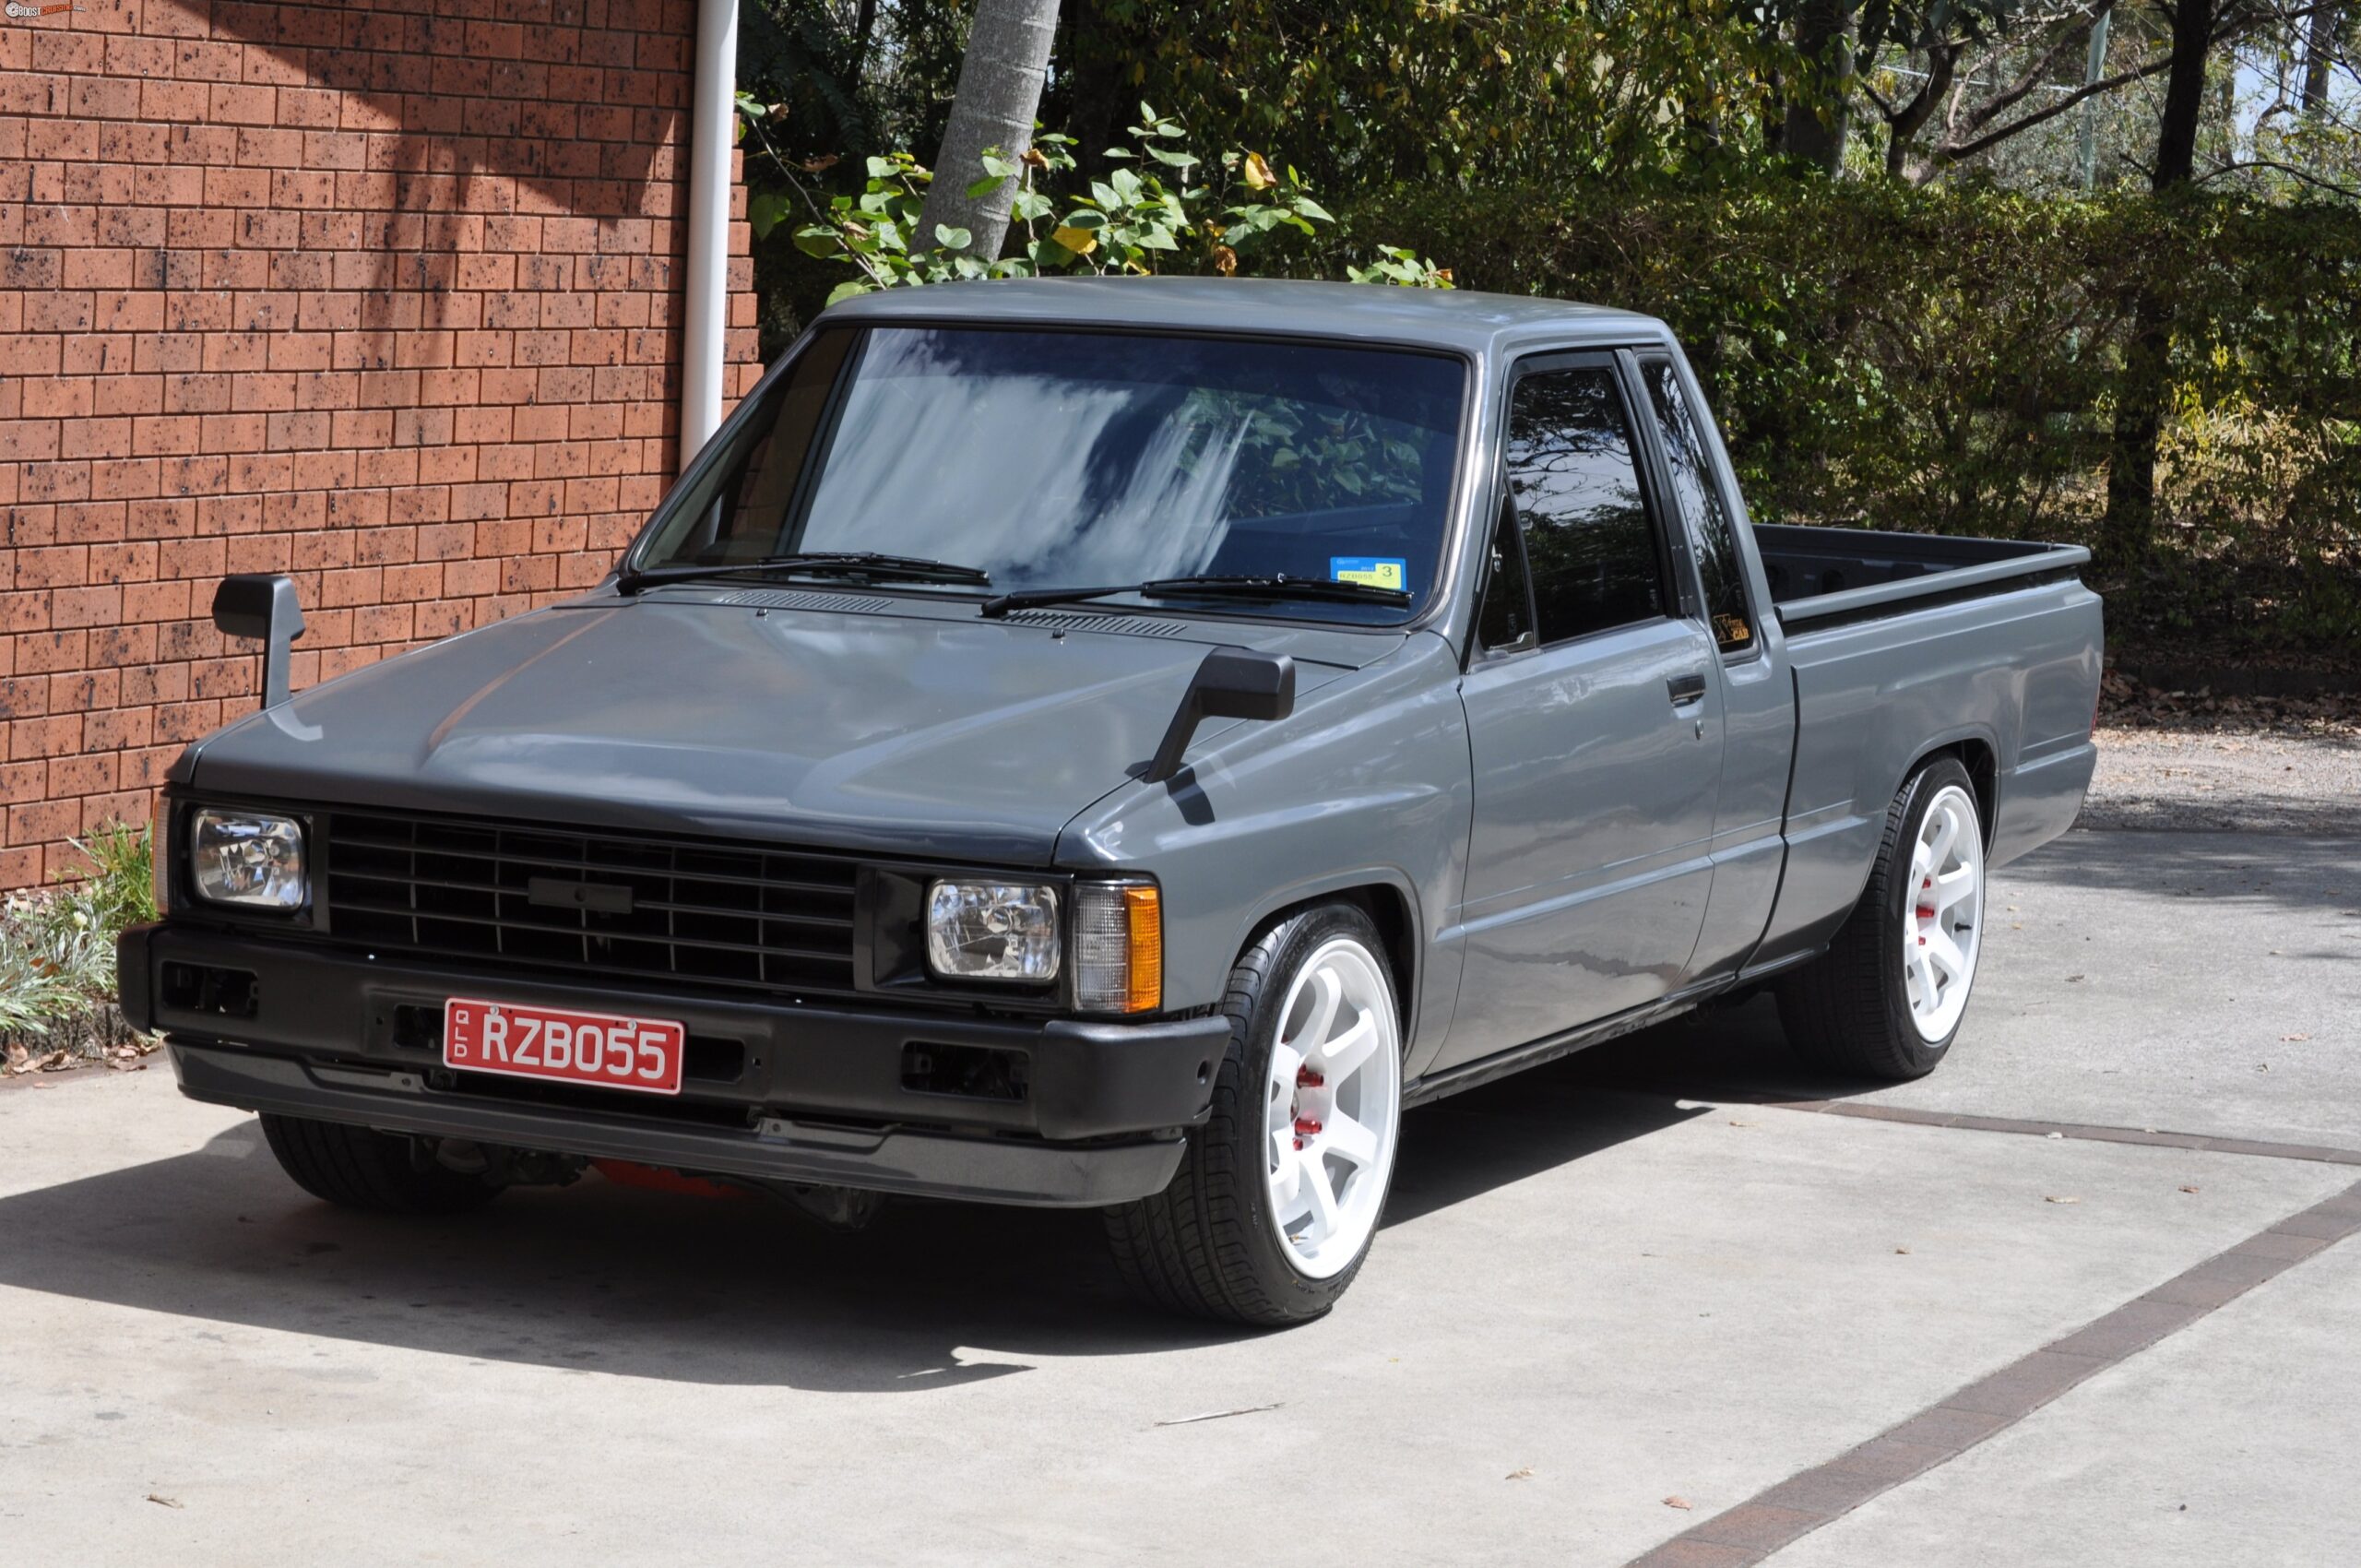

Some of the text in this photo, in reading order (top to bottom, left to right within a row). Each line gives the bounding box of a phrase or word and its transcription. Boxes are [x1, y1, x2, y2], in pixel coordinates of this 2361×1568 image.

[1382, 565, 1393, 577] 3
[455, 1010, 469, 1058] QLD
[482, 1013, 667, 1079] RZB055
